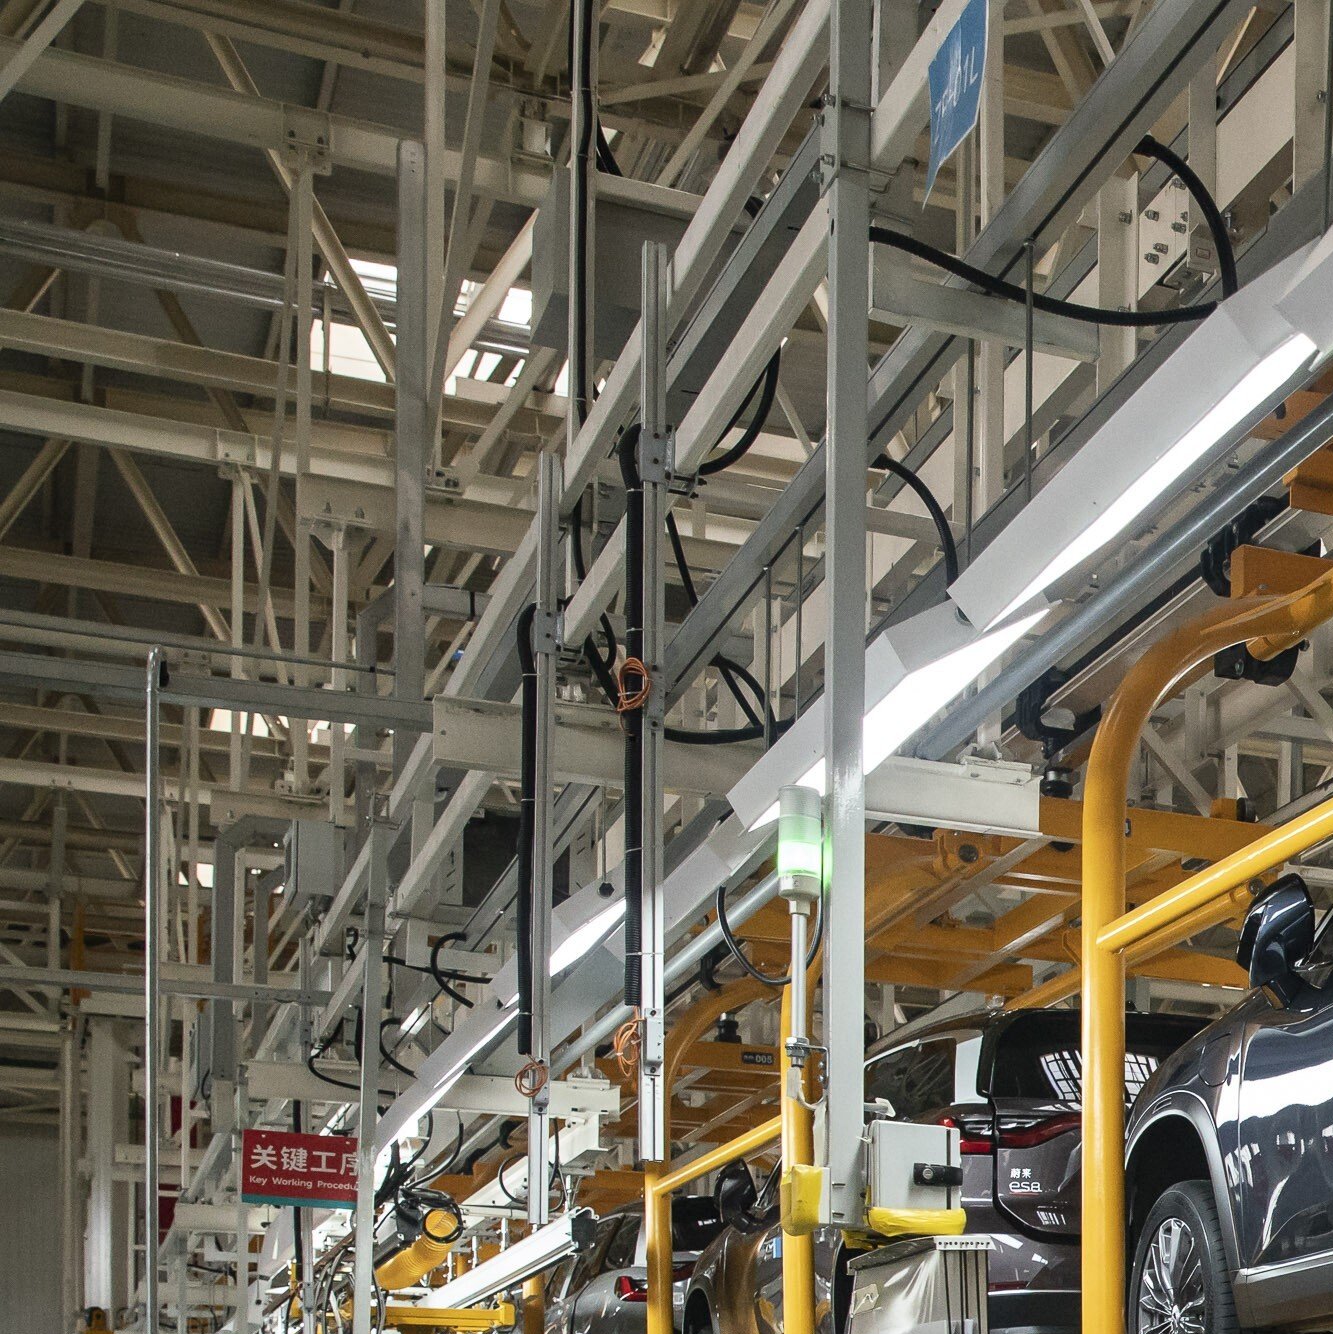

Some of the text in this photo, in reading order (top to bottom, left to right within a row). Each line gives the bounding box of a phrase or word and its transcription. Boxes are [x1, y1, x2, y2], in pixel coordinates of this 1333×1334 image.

[1010, 1168, 1032, 1179] 蔚来
[249, 1175, 268, 1186] Key
[272, 1177, 313, 1189] Working
